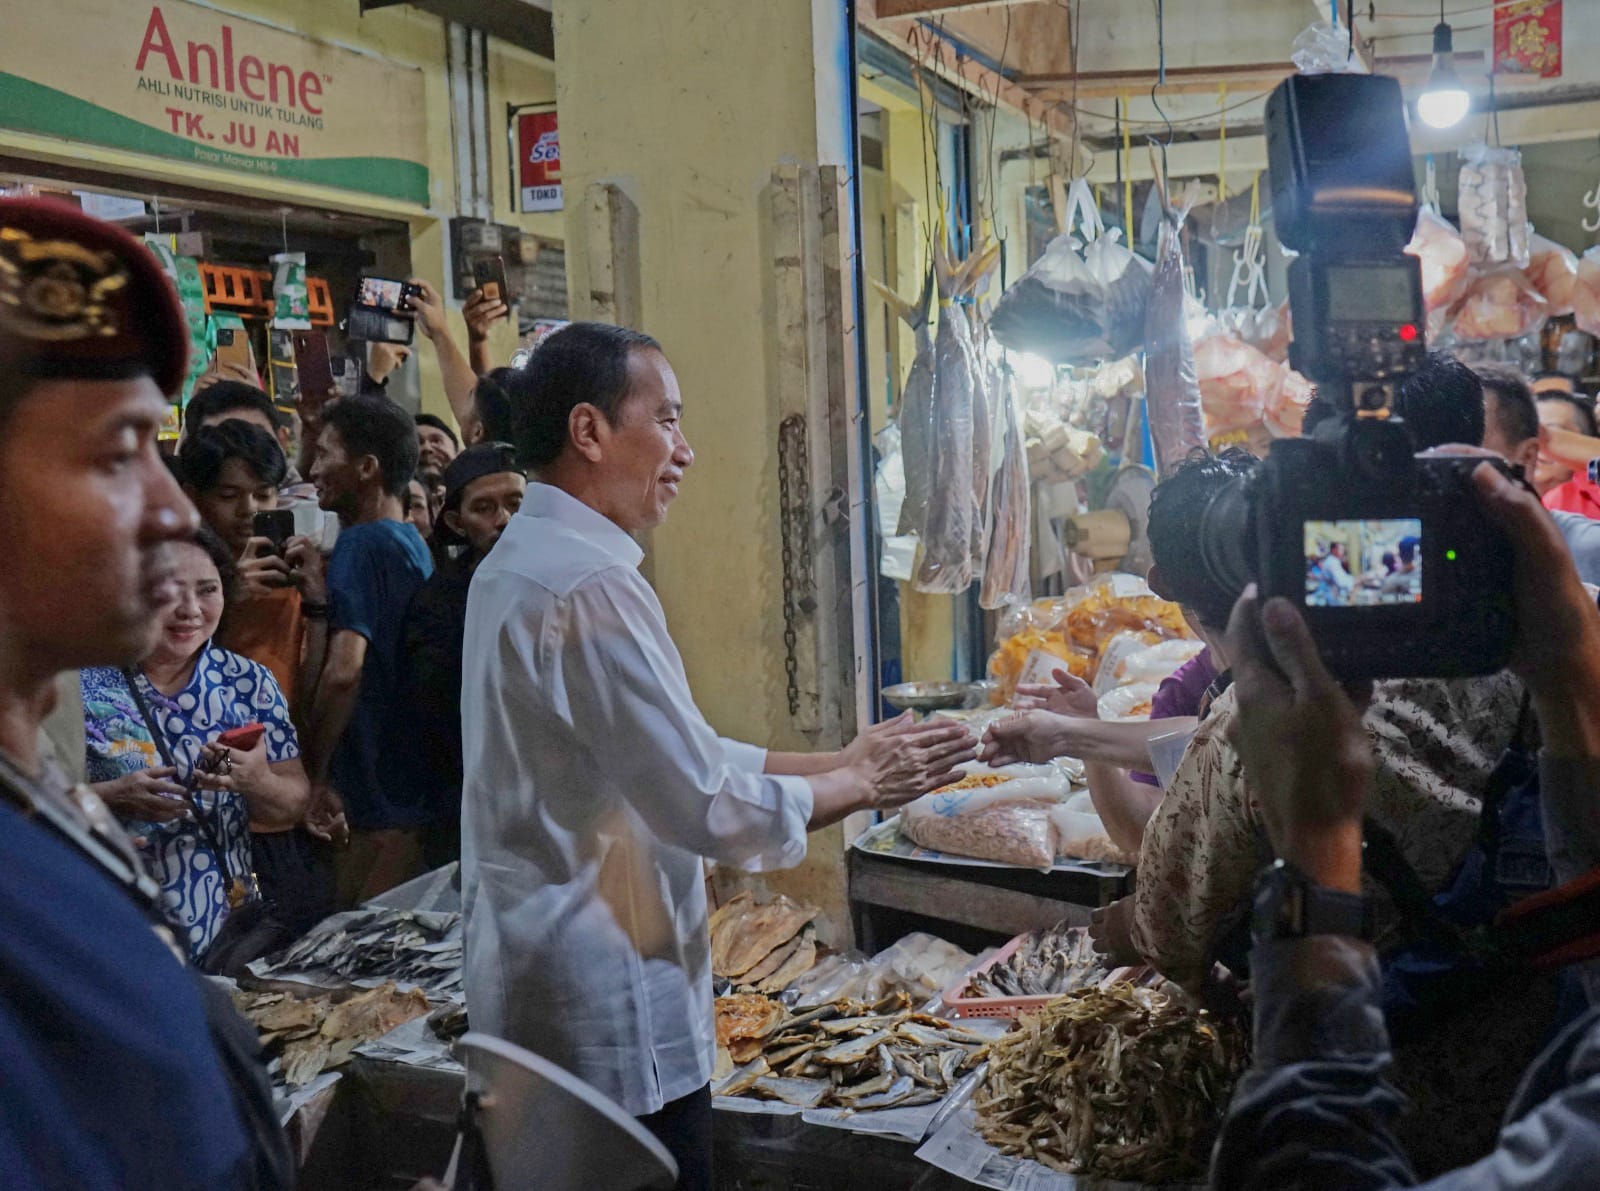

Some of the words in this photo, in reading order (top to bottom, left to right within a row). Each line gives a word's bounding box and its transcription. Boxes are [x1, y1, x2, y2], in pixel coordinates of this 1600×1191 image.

[135, 6, 323, 115] Anlene
[137, 76, 170, 96] AHLI
[174, 84, 227, 109] NUTRISI
[230, 97, 273, 119] UNTUK
[276, 107, 324, 131] TULANG
[165, 107, 214, 140] TK.
[222, 120, 256, 149] JU
[265, 129, 299, 158] AN
[530, 188, 558, 201] TOKO
